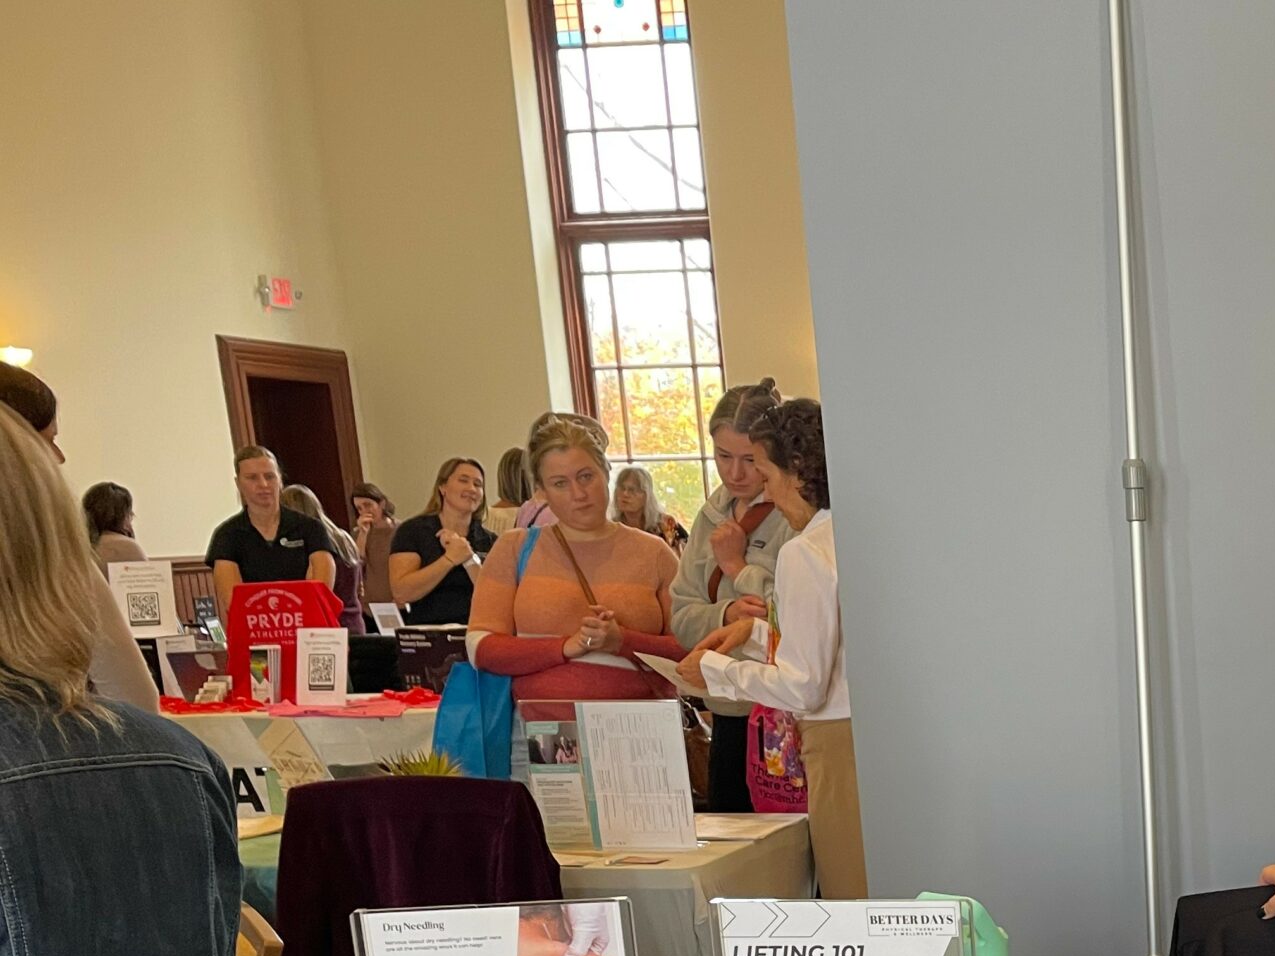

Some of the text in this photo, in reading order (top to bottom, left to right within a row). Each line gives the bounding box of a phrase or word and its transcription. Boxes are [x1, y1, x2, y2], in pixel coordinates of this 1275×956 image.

[247, 612, 304, 629] PRYDE
[870, 914, 953, 924] BETTER DAYS
[382, 921, 444, 933] Dry Needling
